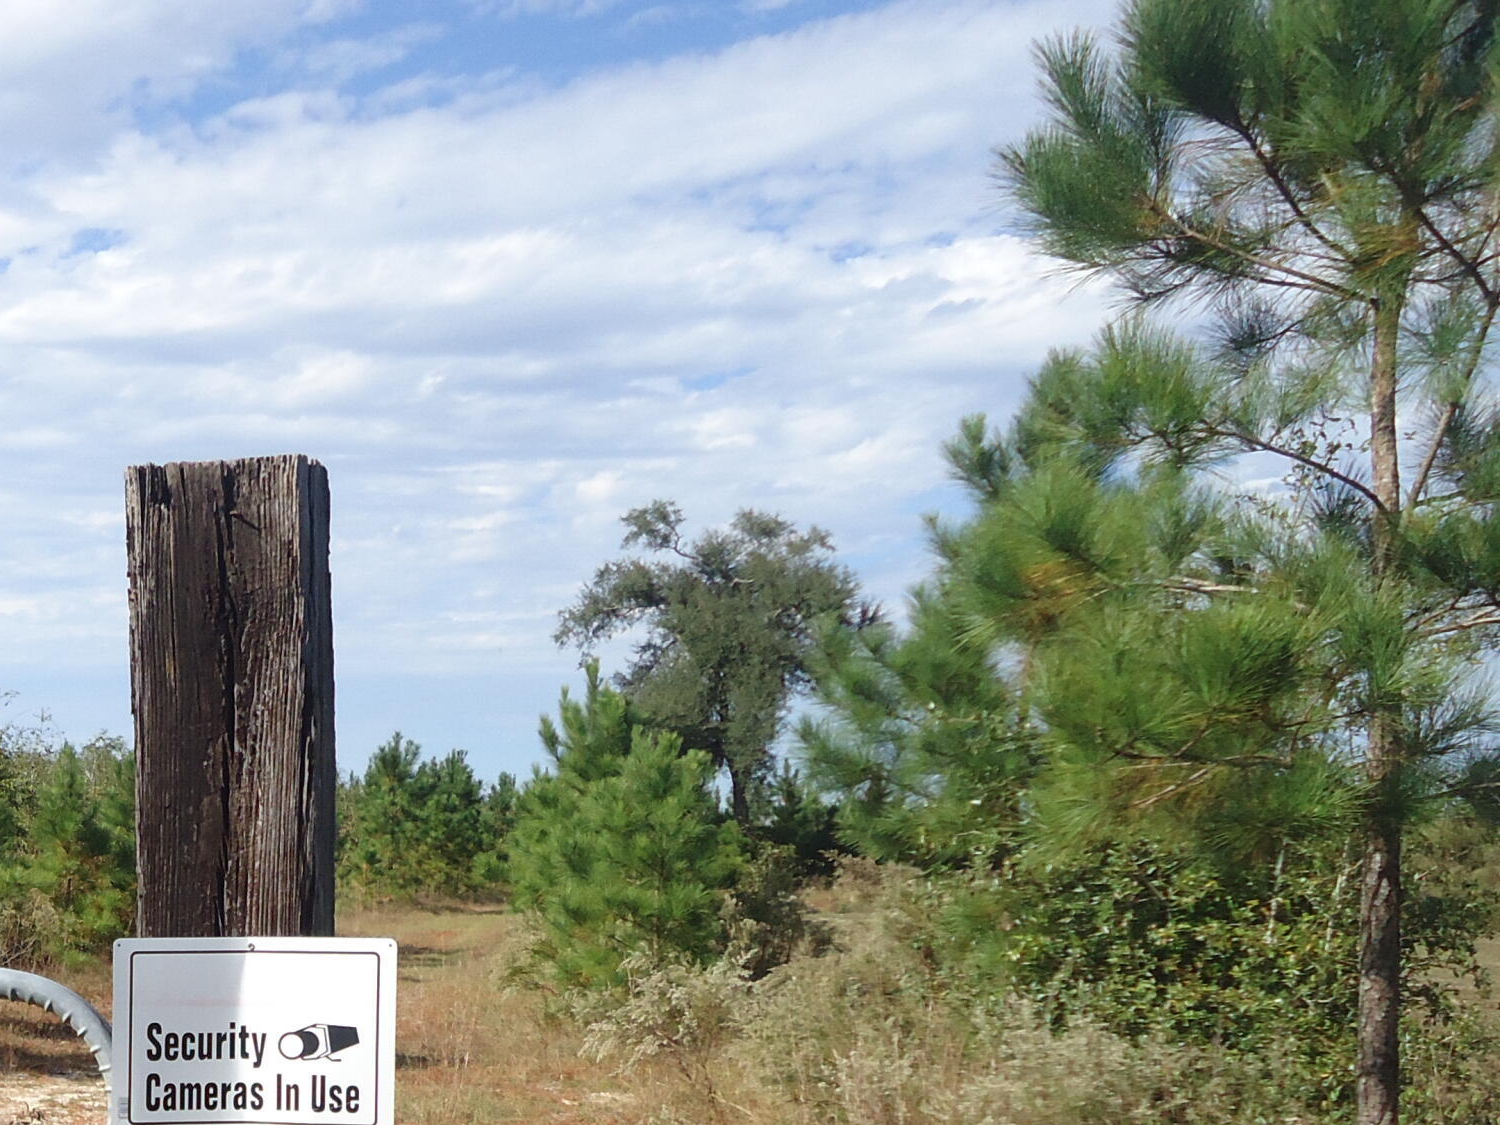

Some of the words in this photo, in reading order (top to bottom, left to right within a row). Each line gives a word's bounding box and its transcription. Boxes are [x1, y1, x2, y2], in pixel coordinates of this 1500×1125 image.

[146, 1022, 267, 1068] Security
[146, 1073, 264, 1112] Cameras
[276, 1074, 299, 1111] In
[311, 1075, 360, 1113] Use
